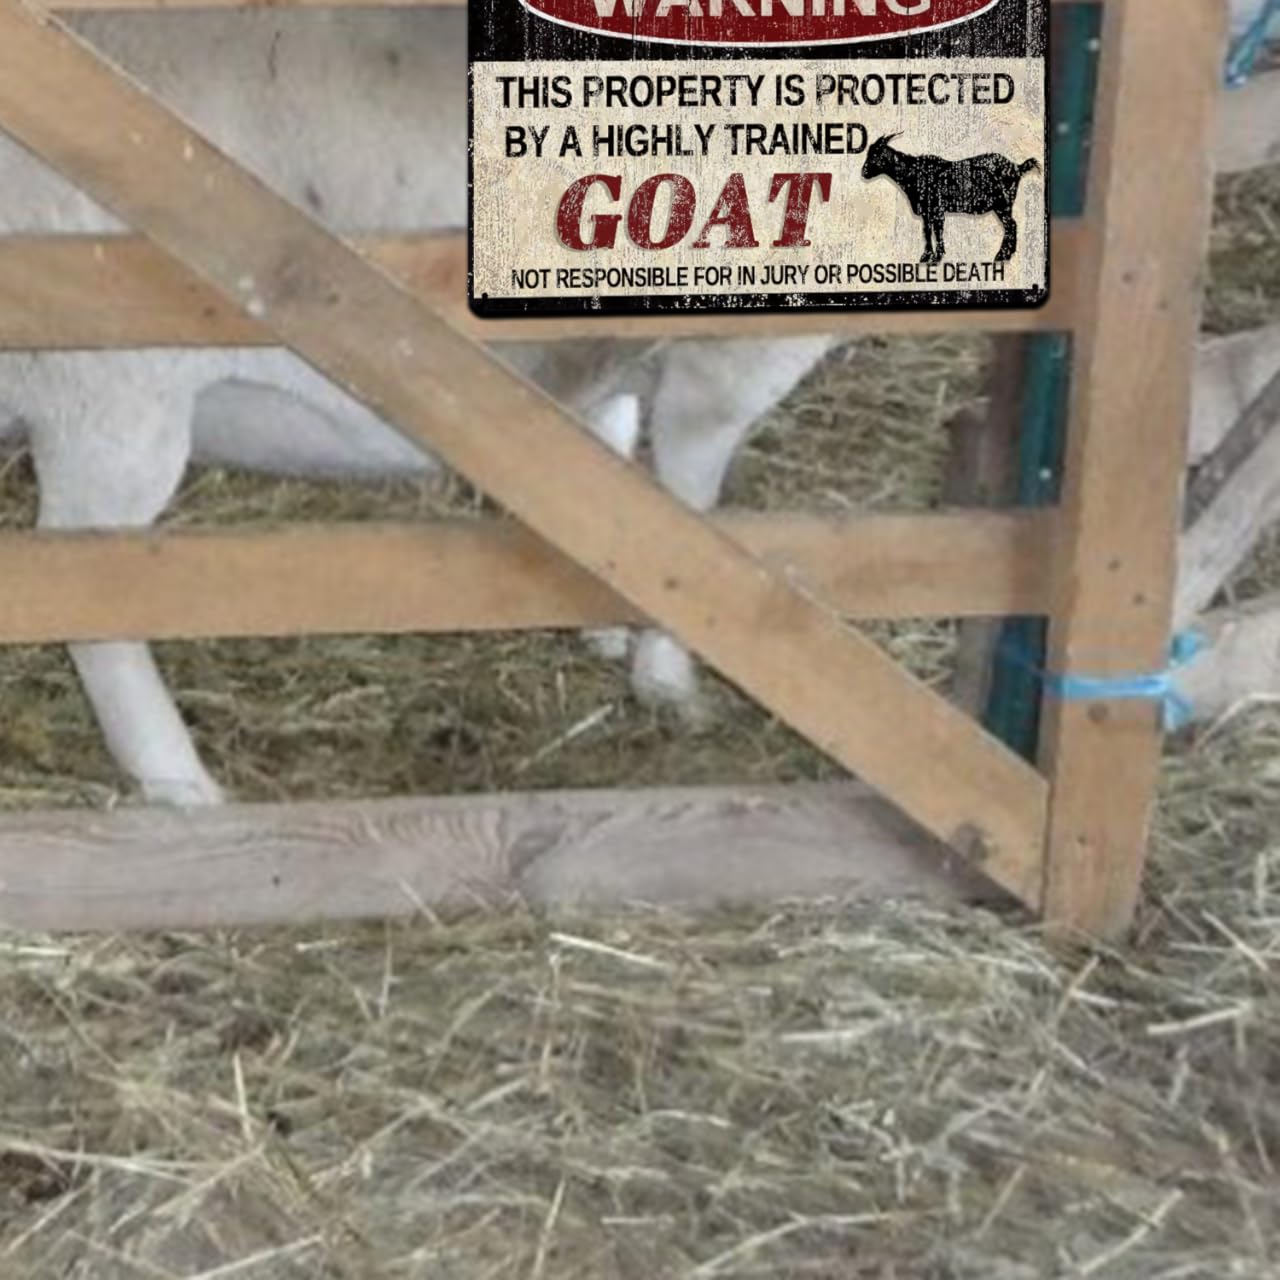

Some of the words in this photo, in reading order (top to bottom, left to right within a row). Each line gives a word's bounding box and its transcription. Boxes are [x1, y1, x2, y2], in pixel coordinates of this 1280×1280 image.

[496, 75, 573, 109] THIS
[582, 74, 766, 108] PROPERTY
[775, 74, 805, 106] IS
[814, 72, 1015, 106] PROTECTED
[505, 125, 549, 158] BY
[559, 125, 583, 158] A
[592, 123, 717, 157] HIGHLY
[724, 122, 869, 156] TRAINED
[555, 172, 832, 251] GOAT
[512, 268, 551, 289] NOT
[556, 266, 689, 288] RESPONSIBLE
[694, 265, 732, 286] FOR
[814, 264, 843, 285] OR
[847, 262, 938, 285] POSSIBLE
[942, 261, 1006, 283] DEATH
